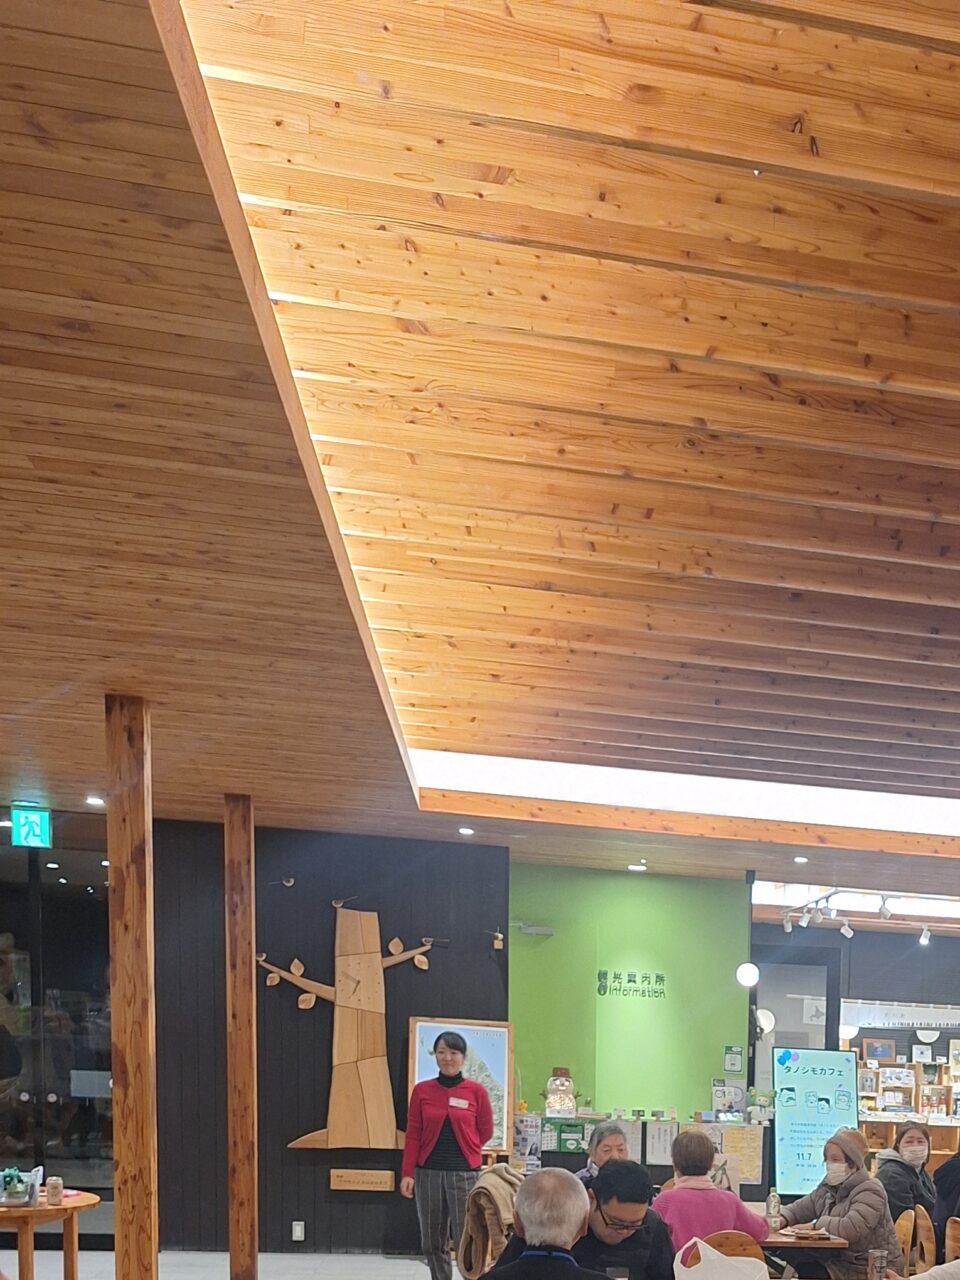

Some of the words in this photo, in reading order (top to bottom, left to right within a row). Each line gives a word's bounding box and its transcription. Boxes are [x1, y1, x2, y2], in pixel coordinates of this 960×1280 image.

[784, 1066, 844, 1077] タノシモカフェ
